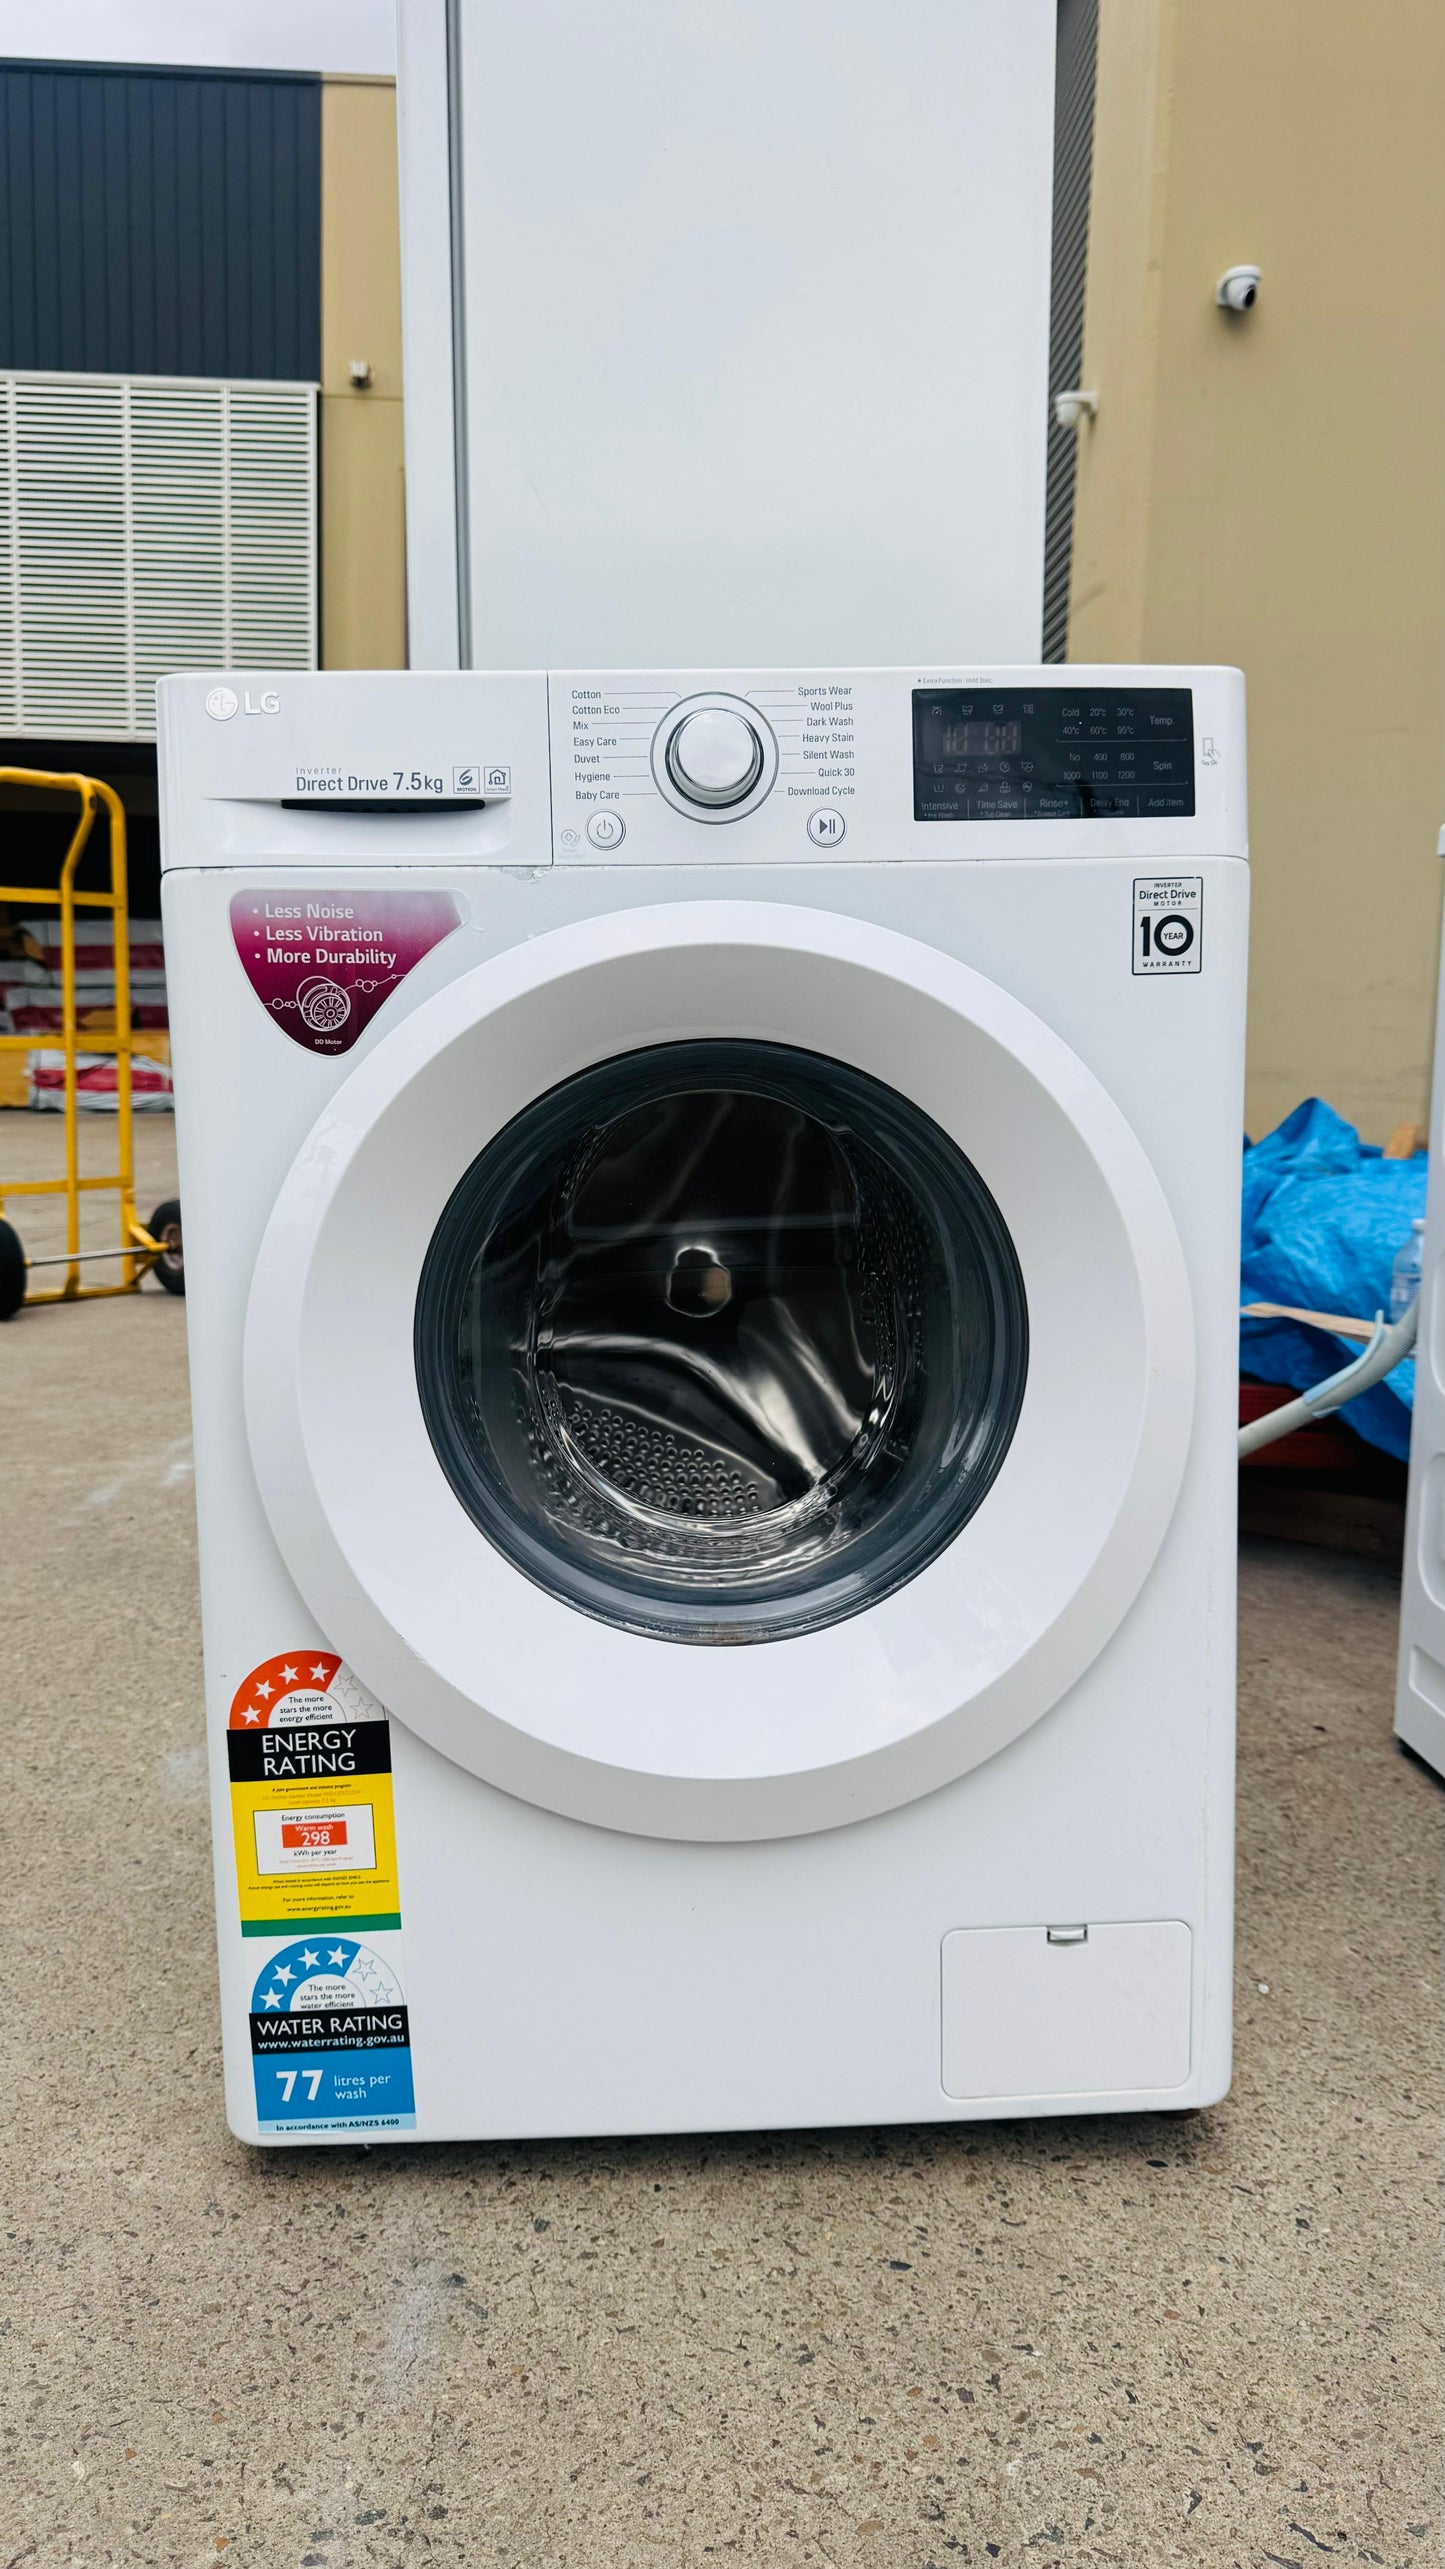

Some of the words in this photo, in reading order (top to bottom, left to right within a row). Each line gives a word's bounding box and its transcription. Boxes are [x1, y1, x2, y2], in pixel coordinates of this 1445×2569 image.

[571, 690, 602, 699] Cotton
[798, 686, 827, 698] Sports
[829, 686, 853, 696] Wear
[244, 690, 281, 715] LG
[810, 701, 833, 711] Wool
[835, 701, 853, 711] Plus
[572, 705, 602, 715] Cotton
[603, 704, 621, 714] Eco
[1061, 708, 1080, 717] Cold
[573, 721, 589, 730] Mix
[806, 716, 827, 727] Dark
[828, 716, 854, 726] Wash
[573, 737, 593, 748] Easy
[595, 736, 617, 747] Care
[802, 733, 830, 744] Heavy
[831, 733, 855, 743] Stain
[574, 754, 600, 764] Duvet
[803, 749, 828, 760] Silent
[829, 750, 855, 760] Wash
[1069, 753, 1081, 761] No
[1153, 761, 1173, 772] Spin
[295, 766, 343, 775] Inverter
[818, 768, 842, 778] Quick
[844, 768, 855, 777] 30
[575, 771, 611, 783] Hygiene
[296, 776, 344, 791] Direct
[347, 776, 389, 791] Drive
[575, 790, 597, 801] Baby
[598, 790, 620, 800] Care
[787, 786, 829, 797] Download
[831, 786, 856, 798] Cycle
[921, 801, 959, 811] Intensive
[976, 800, 996, 809] Time
[997, 800, 1018, 809] Save
[1148, 798, 1165, 807] Add
[1139, 890, 1169, 900] Direct
[1170, 889, 1197, 899] Drive
[264, 903, 302, 919] Less
[306, 903, 354, 919] Noise
[266, 926, 303, 941] Less
[307, 926, 383, 942] Vibration
[1140, 914, 1194, 957] 10
[1163, 932, 1184, 940] YEAR
[267, 948, 311, 964] More
[315, 948, 397, 969] Durability
[1142, 960, 1192, 968] WARRANTY
[288, 1696, 303, 1704] The
[299, 1705, 311, 1713] the
[279, 1715, 303, 1723] energy
[305, 1713, 333, 1721] efficient
[261, 1728, 357, 1754] ENERGY
[263, 1752, 356, 1776] RATING
[281, 1814, 303, 1822] Energy
[304, 1812, 345, 1820] consumption
[301, 1830, 331, 1847] 298
[311, 1849, 321, 1857] per
[323, 1849, 337, 1857] year
[308, 1984, 323, 1992] The
[324, 2001, 354, 2009] efficient
[257, 2017, 325, 2036] WATER
[329, 2013, 403, 2034] RATING
[257, 2033, 406, 2050] www.waterrating.gov.au
[275, 2069, 324, 2103] 77
[334, 2074, 366, 2087] litres
[369, 2073, 392, 2088] per
[334, 2087, 367, 2101] wash
[276, 2124, 284, 2132] In
[286, 2122, 329, 2132] accordance
[331, 2121, 348, 2129] with
[348, 2119, 380, 2128] AS/NZS
[381, 2118, 400, 2126] 6400
